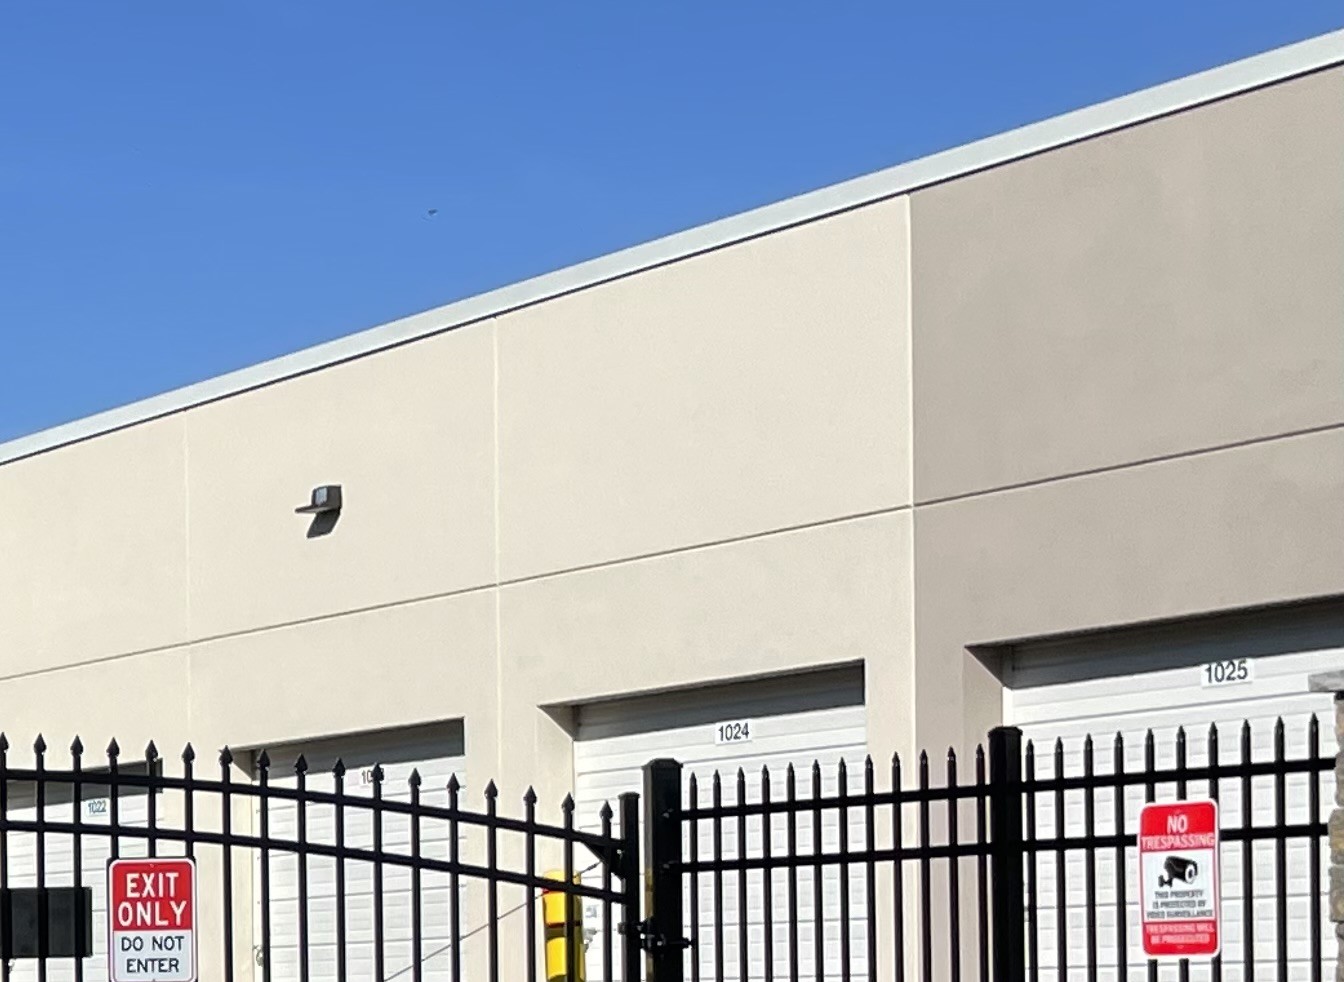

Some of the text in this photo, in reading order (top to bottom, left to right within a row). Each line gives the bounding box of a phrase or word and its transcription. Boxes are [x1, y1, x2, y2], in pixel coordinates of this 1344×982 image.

[1205, 659, 1248, 683] 1025
[718, 722, 750, 741] 1024
[87, 800, 107, 813] 1022
[1166, 814, 1188, 834] NO
[1141, 832, 1215, 850] TRESPASSING
[126, 872, 179, 898] EXIT
[118, 900, 187, 927] ONLY
[121, 936, 185, 952] DO NOT
[126, 958, 180, 973] ENTER
